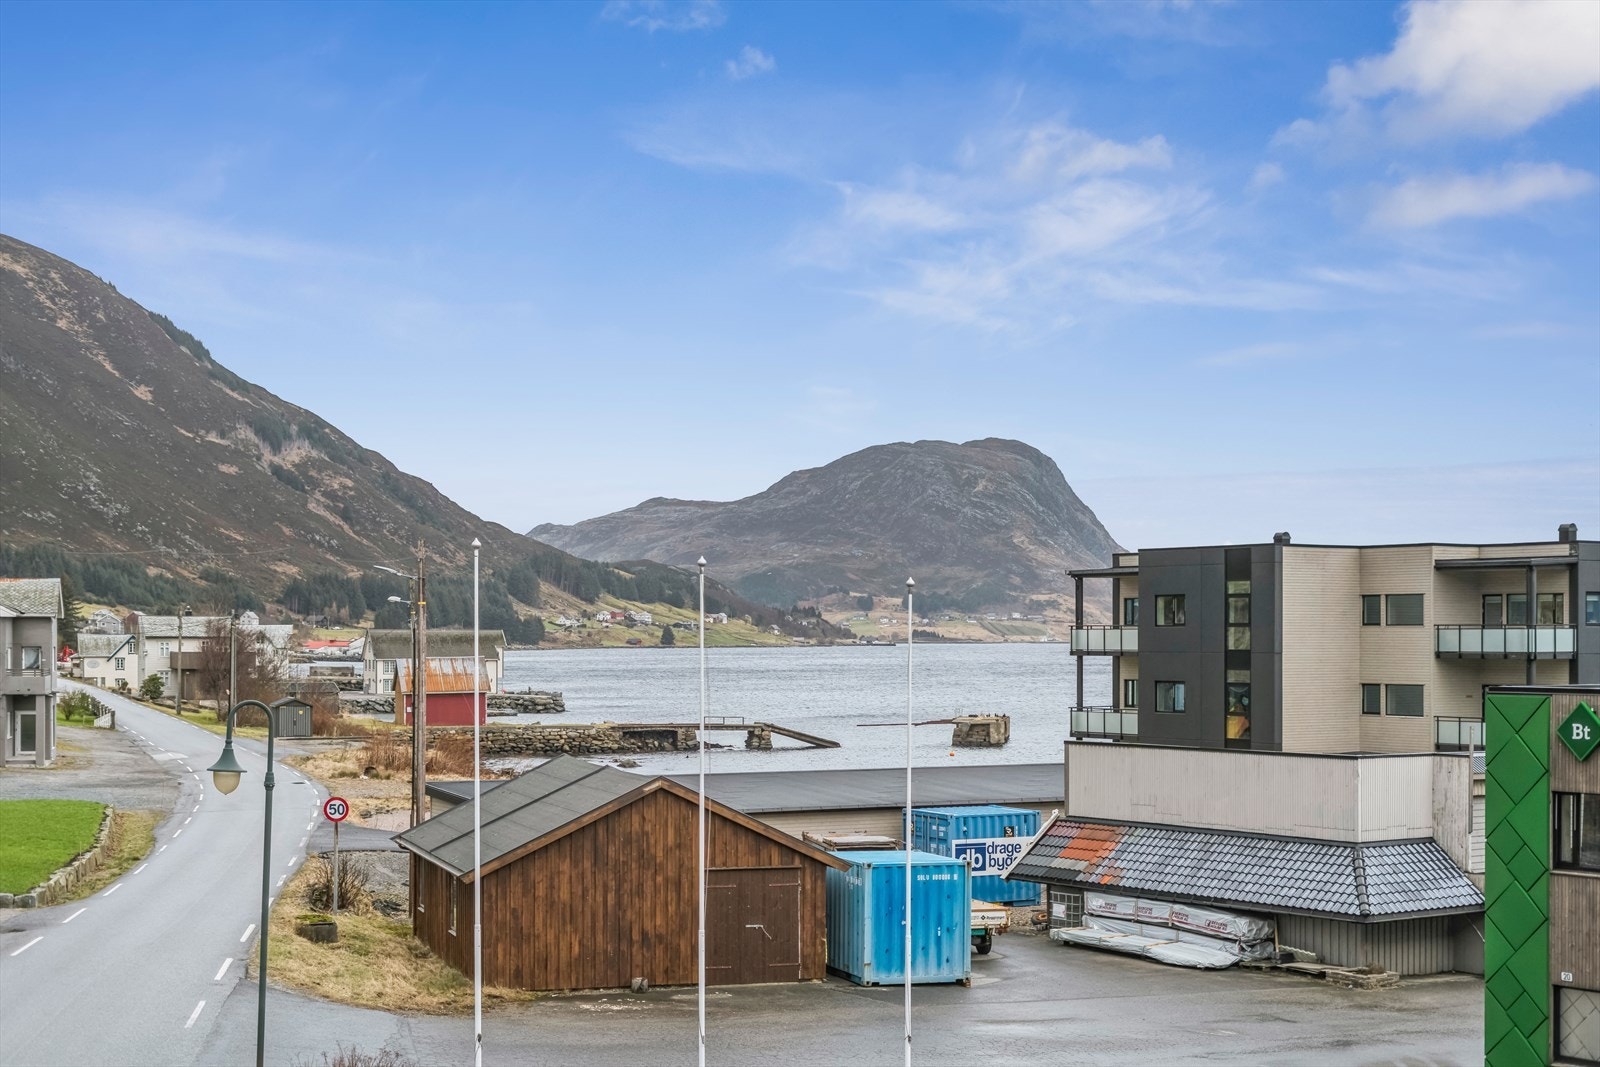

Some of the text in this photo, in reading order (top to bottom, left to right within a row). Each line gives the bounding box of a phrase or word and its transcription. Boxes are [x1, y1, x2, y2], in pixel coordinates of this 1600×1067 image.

[1572, 723, 1590, 740] Bt
[329, 803, 345, 815] 50
[987, 842, 1021, 857] drage
